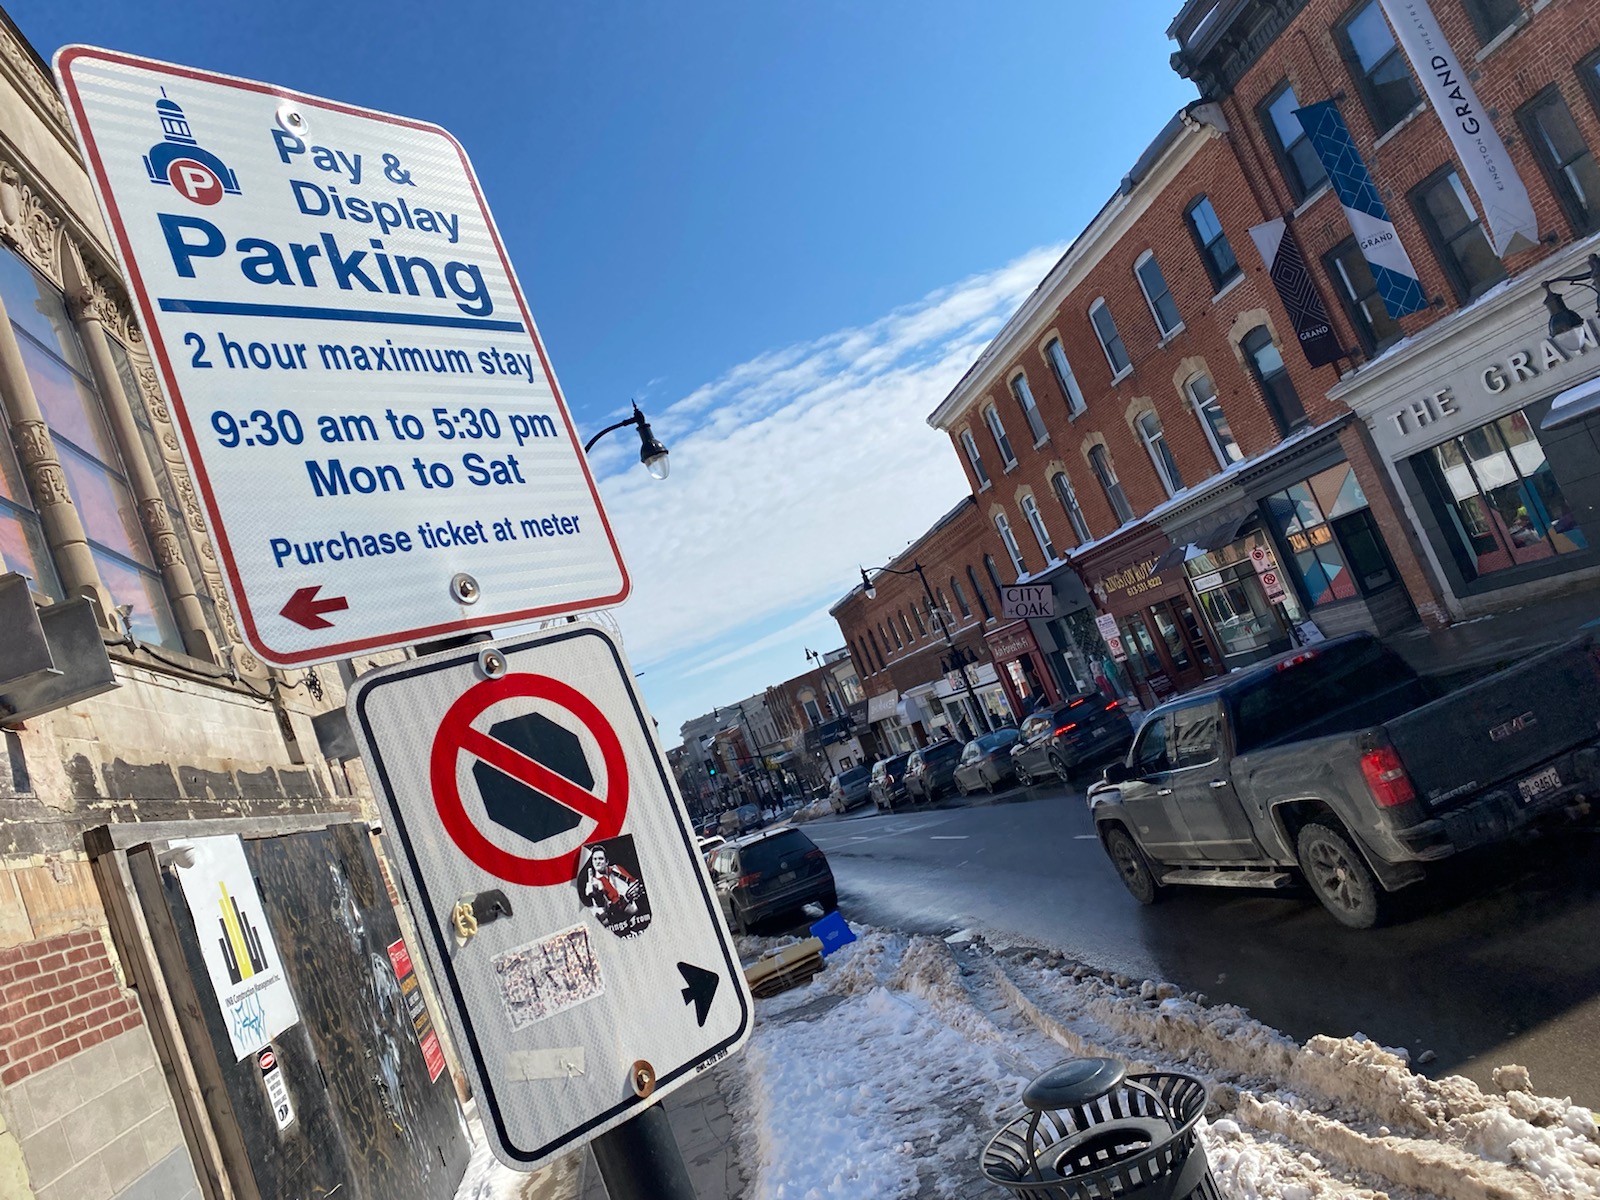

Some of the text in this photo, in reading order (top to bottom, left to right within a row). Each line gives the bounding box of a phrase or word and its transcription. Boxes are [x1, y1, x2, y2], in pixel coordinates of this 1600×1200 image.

[1405, 3, 1504, 191] KINGSTON GRAND THEATRE
[270, 128, 418, 187] Pay &
[289, 179, 459, 245] Display
[157, 213, 494, 318] Parking
[1360, 233, 1393, 250] GRAND
[184, 332, 534, 383] 2 hour maximum stay
[1300, 325, 1329, 341] GRAND
[211, 408, 558, 449] 9:30 am to 5:30 pm
[1387, 388, 1457, 437] THE
[305, 452, 527, 498] Mon to Sat
[270, 513, 581, 569] Purchase ticket at meter
[1006, 587, 1045, 603] CITY
[1489, 711, 1537, 741] GMC
